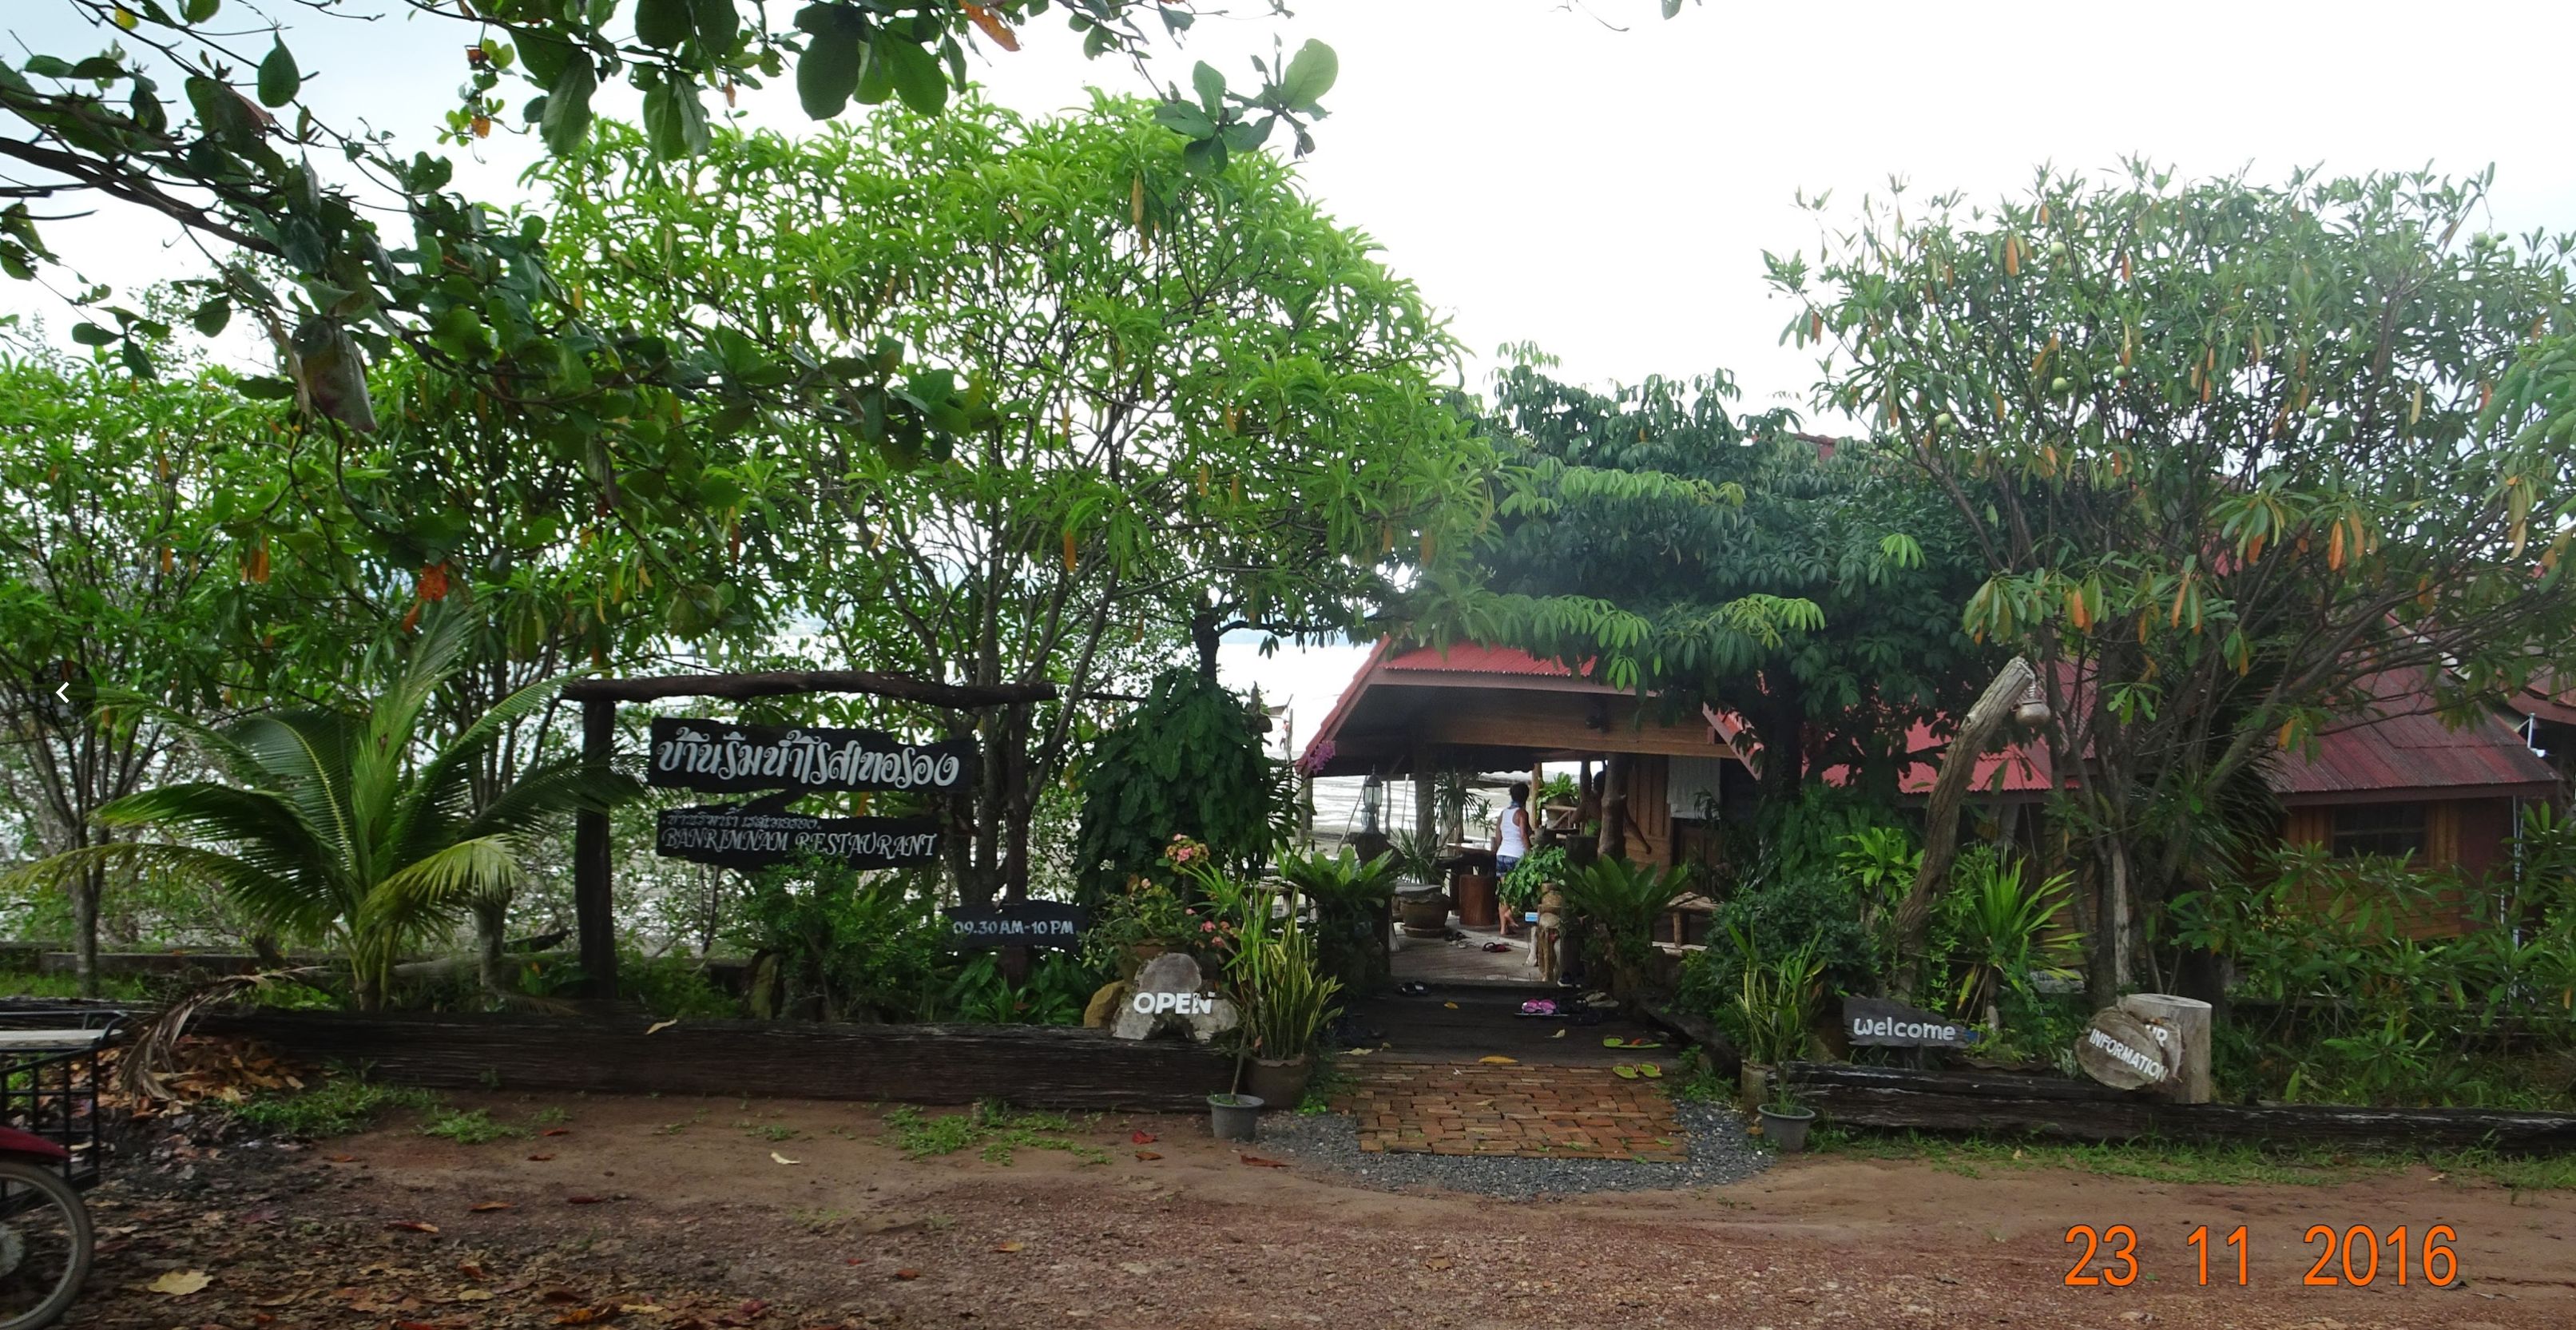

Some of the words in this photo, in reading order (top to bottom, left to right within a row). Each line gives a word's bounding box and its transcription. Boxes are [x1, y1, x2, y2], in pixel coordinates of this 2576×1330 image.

[661, 828, 789, 853] BANRIMNAM
[795, 831, 938, 860] RESTAURANT
[1050, 920, 1074, 935] PM
[1133, 991, 1215, 1014] OPEN
[2089, 1028, 2169, 1083] INFORMATION
